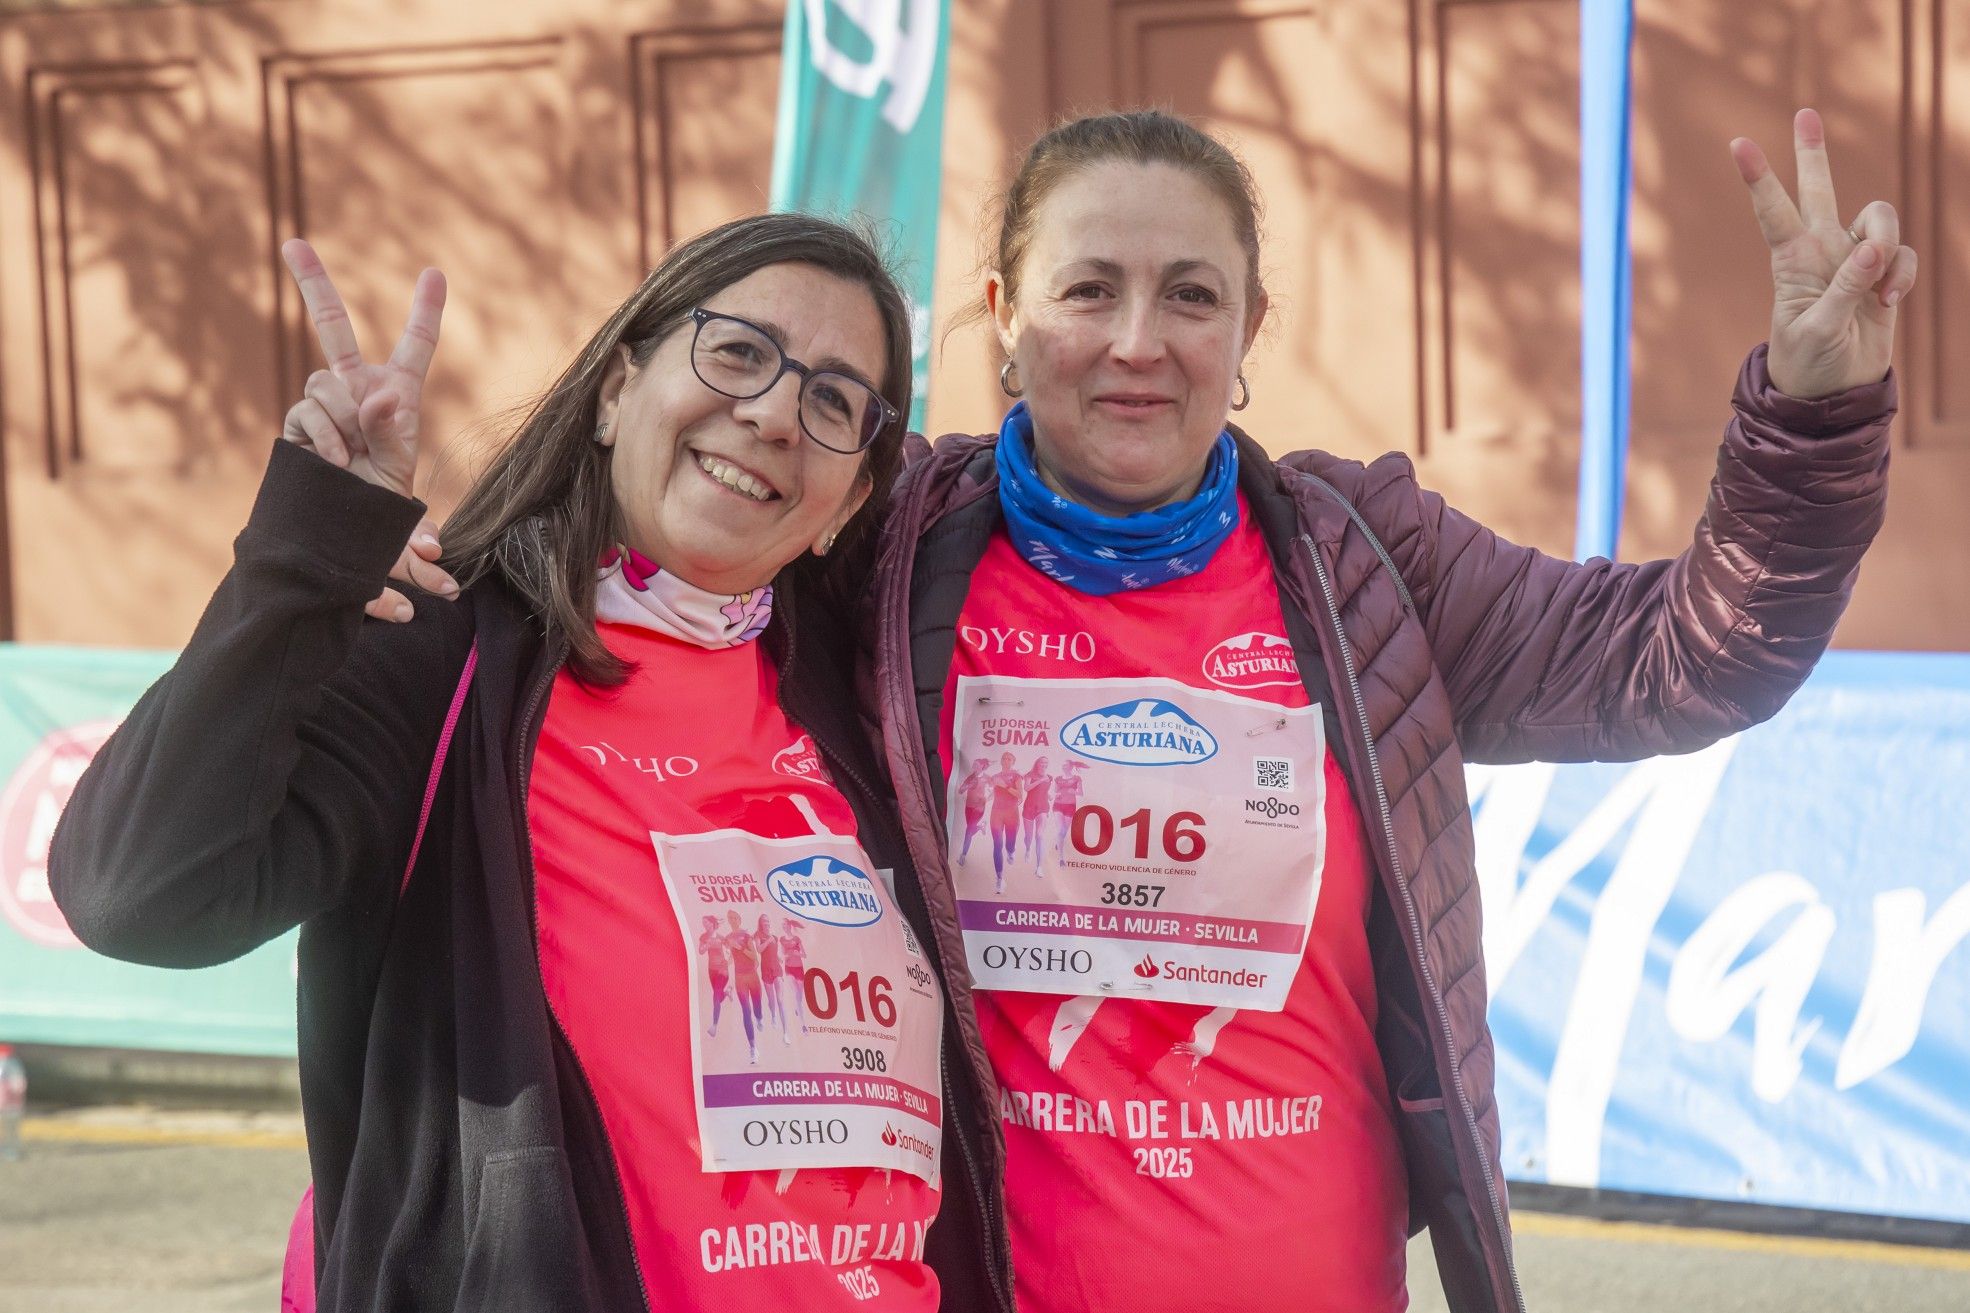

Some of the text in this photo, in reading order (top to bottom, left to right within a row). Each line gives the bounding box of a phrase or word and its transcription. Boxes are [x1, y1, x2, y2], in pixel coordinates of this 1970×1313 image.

[961, 625, 1096, 662] OYSHO
[1226, 649, 1295, 660] CENTRAL LECH
[1211, 654, 1299, 678] ASTURIAN
[980, 718, 1050, 730] TU DORSAL
[981, 729, 1050, 747] SUMA
[1070, 723, 1207, 756] ASTURIANA
[1098, 721, 1201, 738] CENTRAL LECHERA
[1070, 804, 1207, 863] 016
[689, 873, 757, 885] TU DORSAL
[788, 879, 832, 888] CENTRAL
[1066, 860, 1108, 871] TELÉFONO
[1108, 864, 1151, 874] VIOLENCIA
[1152, 867, 1162, 875] DE
[697, 885, 765, 903] SUMA
[777, 879, 879, 913] ASTURIANA
[1100, 882, 1166, 908] 3857
[996, 909, 1259, 944] CARRERA DE LA MUJER SEVILLA
[982, 945, 1268, 988] OYSHO Santander
[803, 967, 897, 1028] 016
[841, 1046, 887, 1072] 3908
[752, 1079, 928, 1115] CARRERA DE LA MUJER SEVILLA
[1001, 1086, 1323, 1141] ARRERA DE LA MUJER
[743, 1118, 934, 1161] OYSHO Santander
[1133, 1147, 1193, 1179] 2025
[830, 1224, 871, 1266] DE
[870, 1221, 906, 1261] LA
